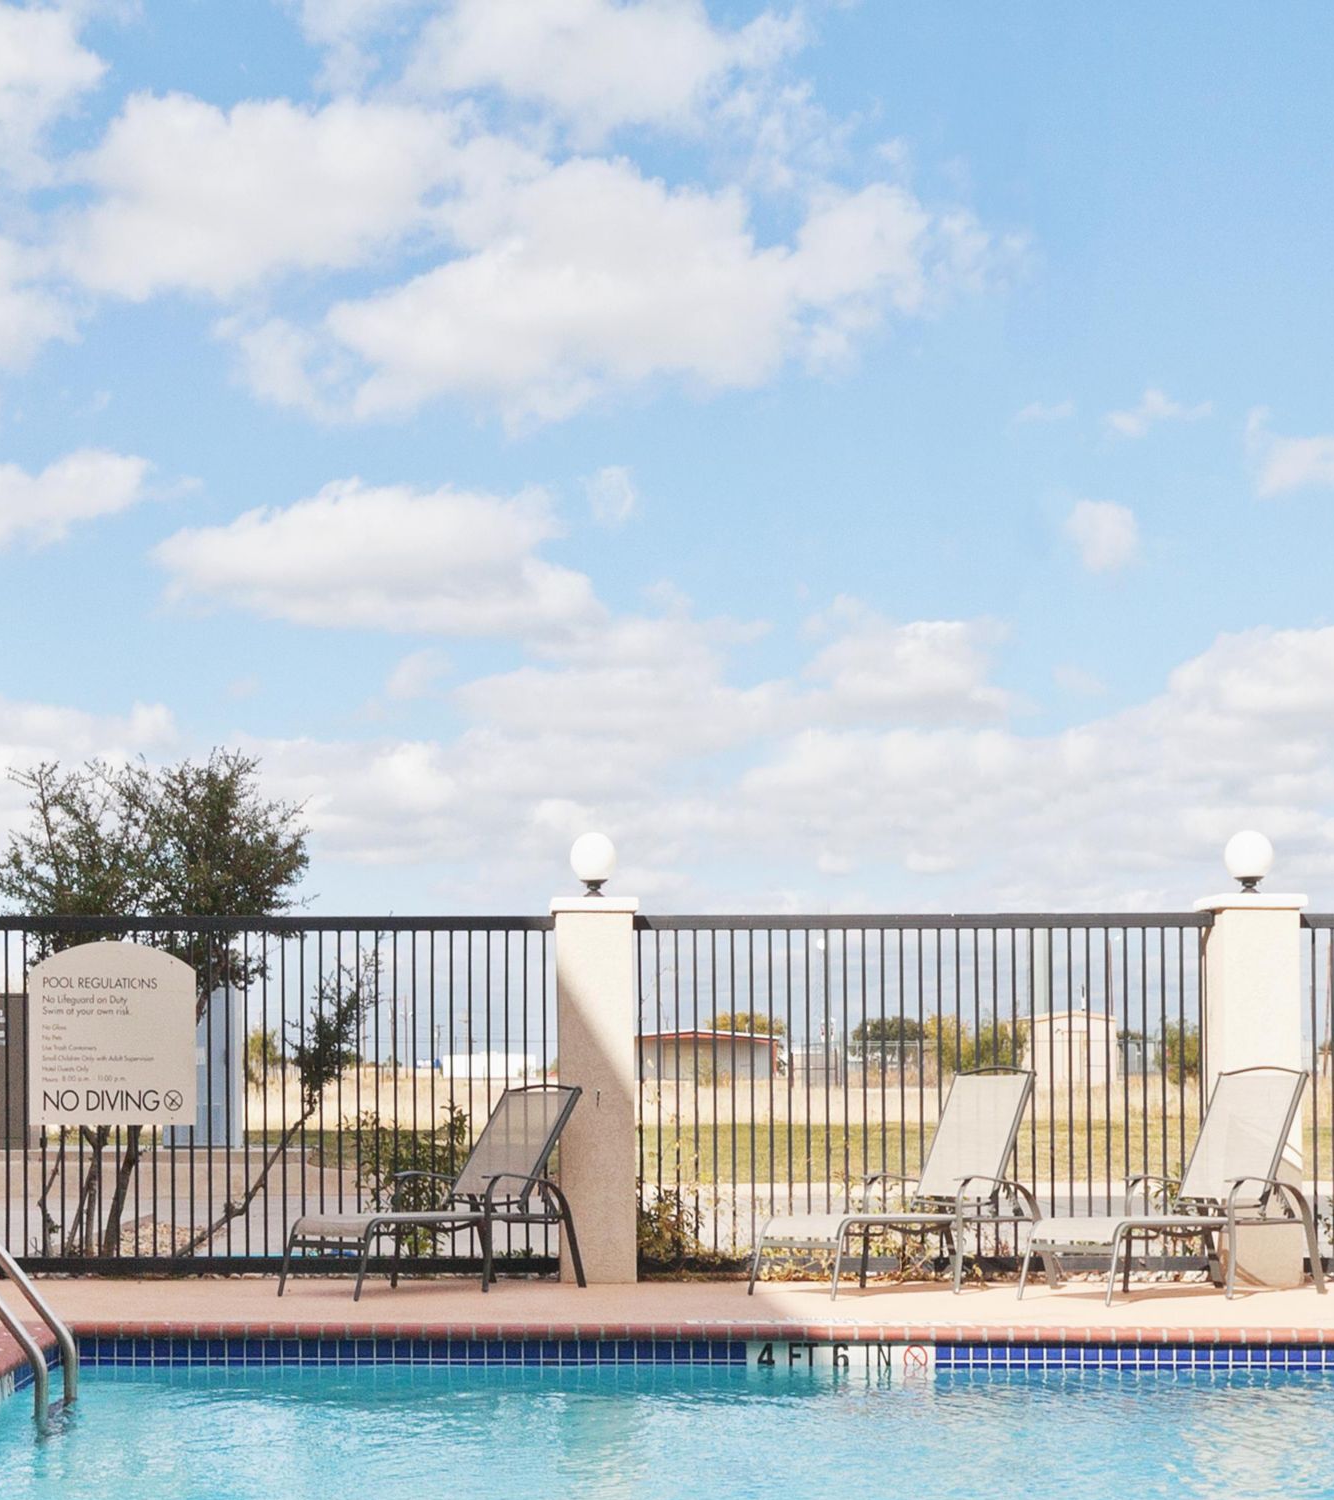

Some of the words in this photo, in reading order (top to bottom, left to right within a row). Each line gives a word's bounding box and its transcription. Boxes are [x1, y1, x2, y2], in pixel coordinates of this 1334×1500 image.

[42, 976, 74, 989] POOL
[78, 976, 158, 990] REGULATIONS
[42, 994, 55, 1004] No
[57, 993, 95, 1007] Lifeguard
[109, 994, 128, 1007] Duty
[42, 1005, 64, 1015] Swim
[66, 1007, 75, 1015] at
[76, 1008, 94, 1018] your
[96, 1008, 114, 1016] own
[42, 1023, 51, 1031] No
[43, 1089, 80, 1112] NO
[86, 1089, 160, 1112] DIVING
[757, 1342, 775, 1367] 4
[789, 1342, 819, 1367] FT
[833, 1342, 849, 1367] 6
[865, 1342, 892, 1367] IN
